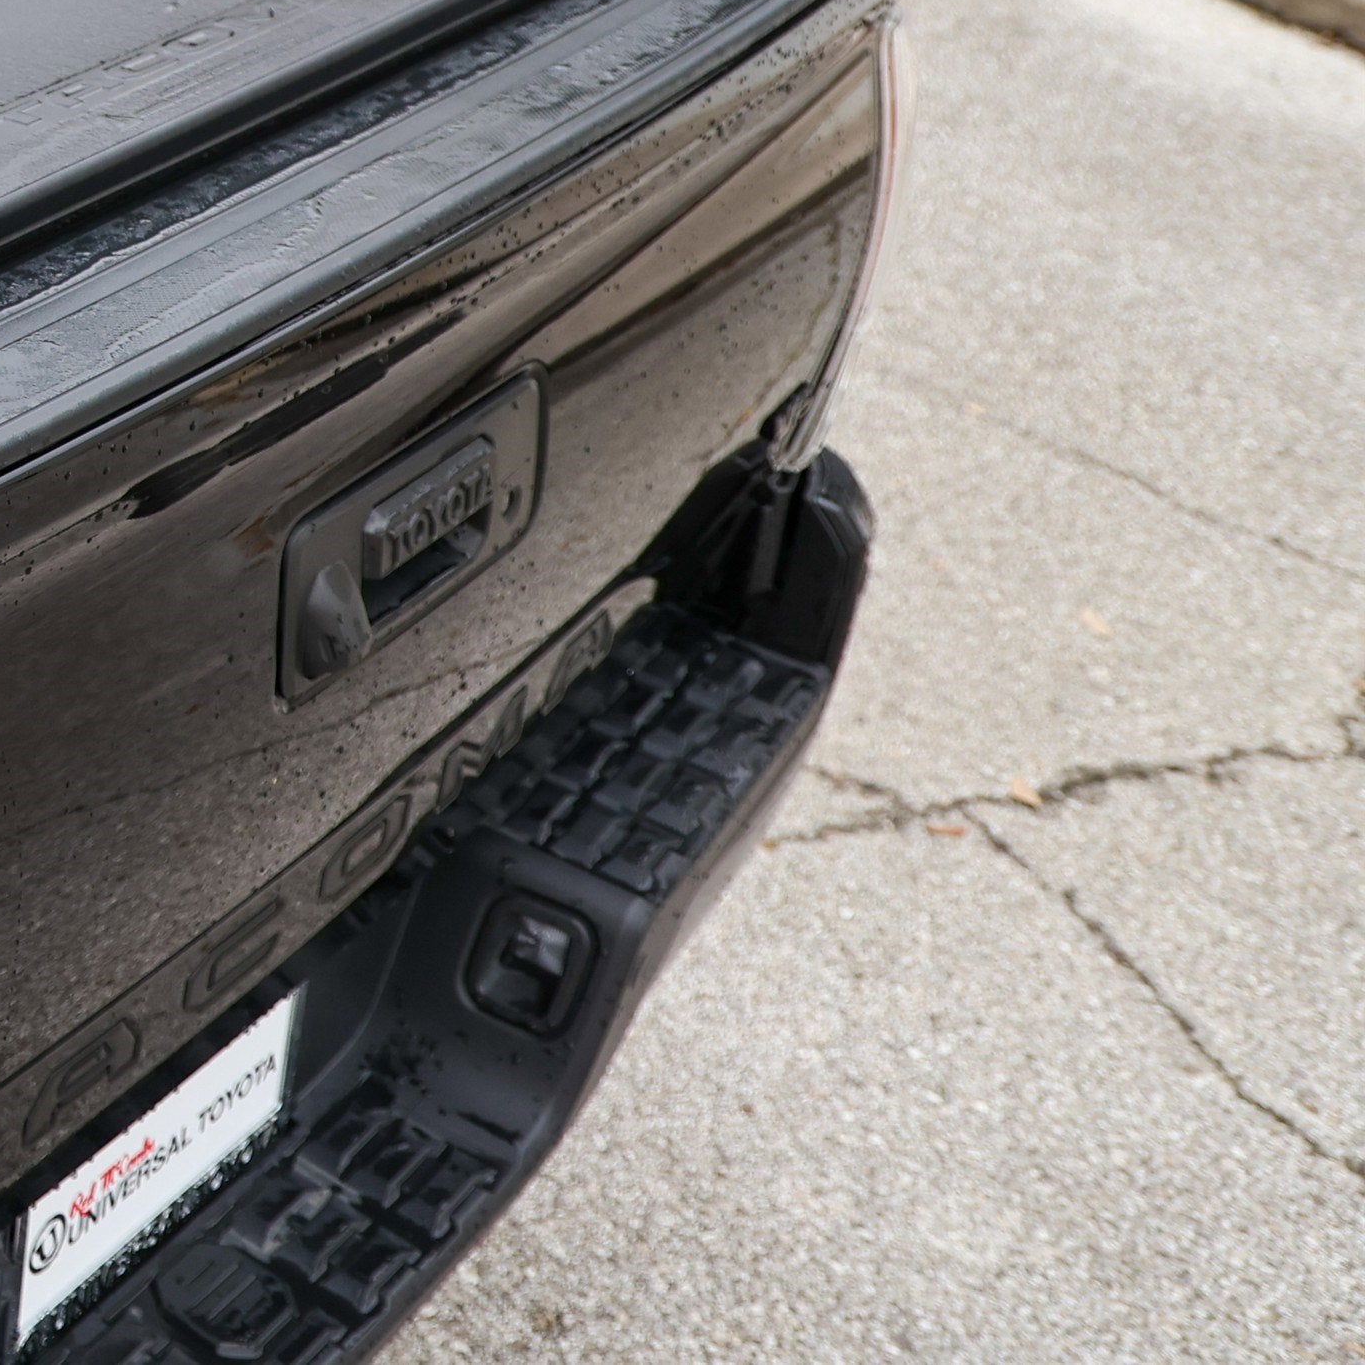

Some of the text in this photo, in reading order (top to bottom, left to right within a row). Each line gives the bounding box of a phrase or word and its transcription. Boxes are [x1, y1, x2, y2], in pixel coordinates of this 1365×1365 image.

[388, 463, 491, 567] TOYOTA
[68, 1126, 192, 1245] UNIVERSAL
[197, 1053, 276, 1132] TOYOTA
[69, 1182, 97, 1218] Red
